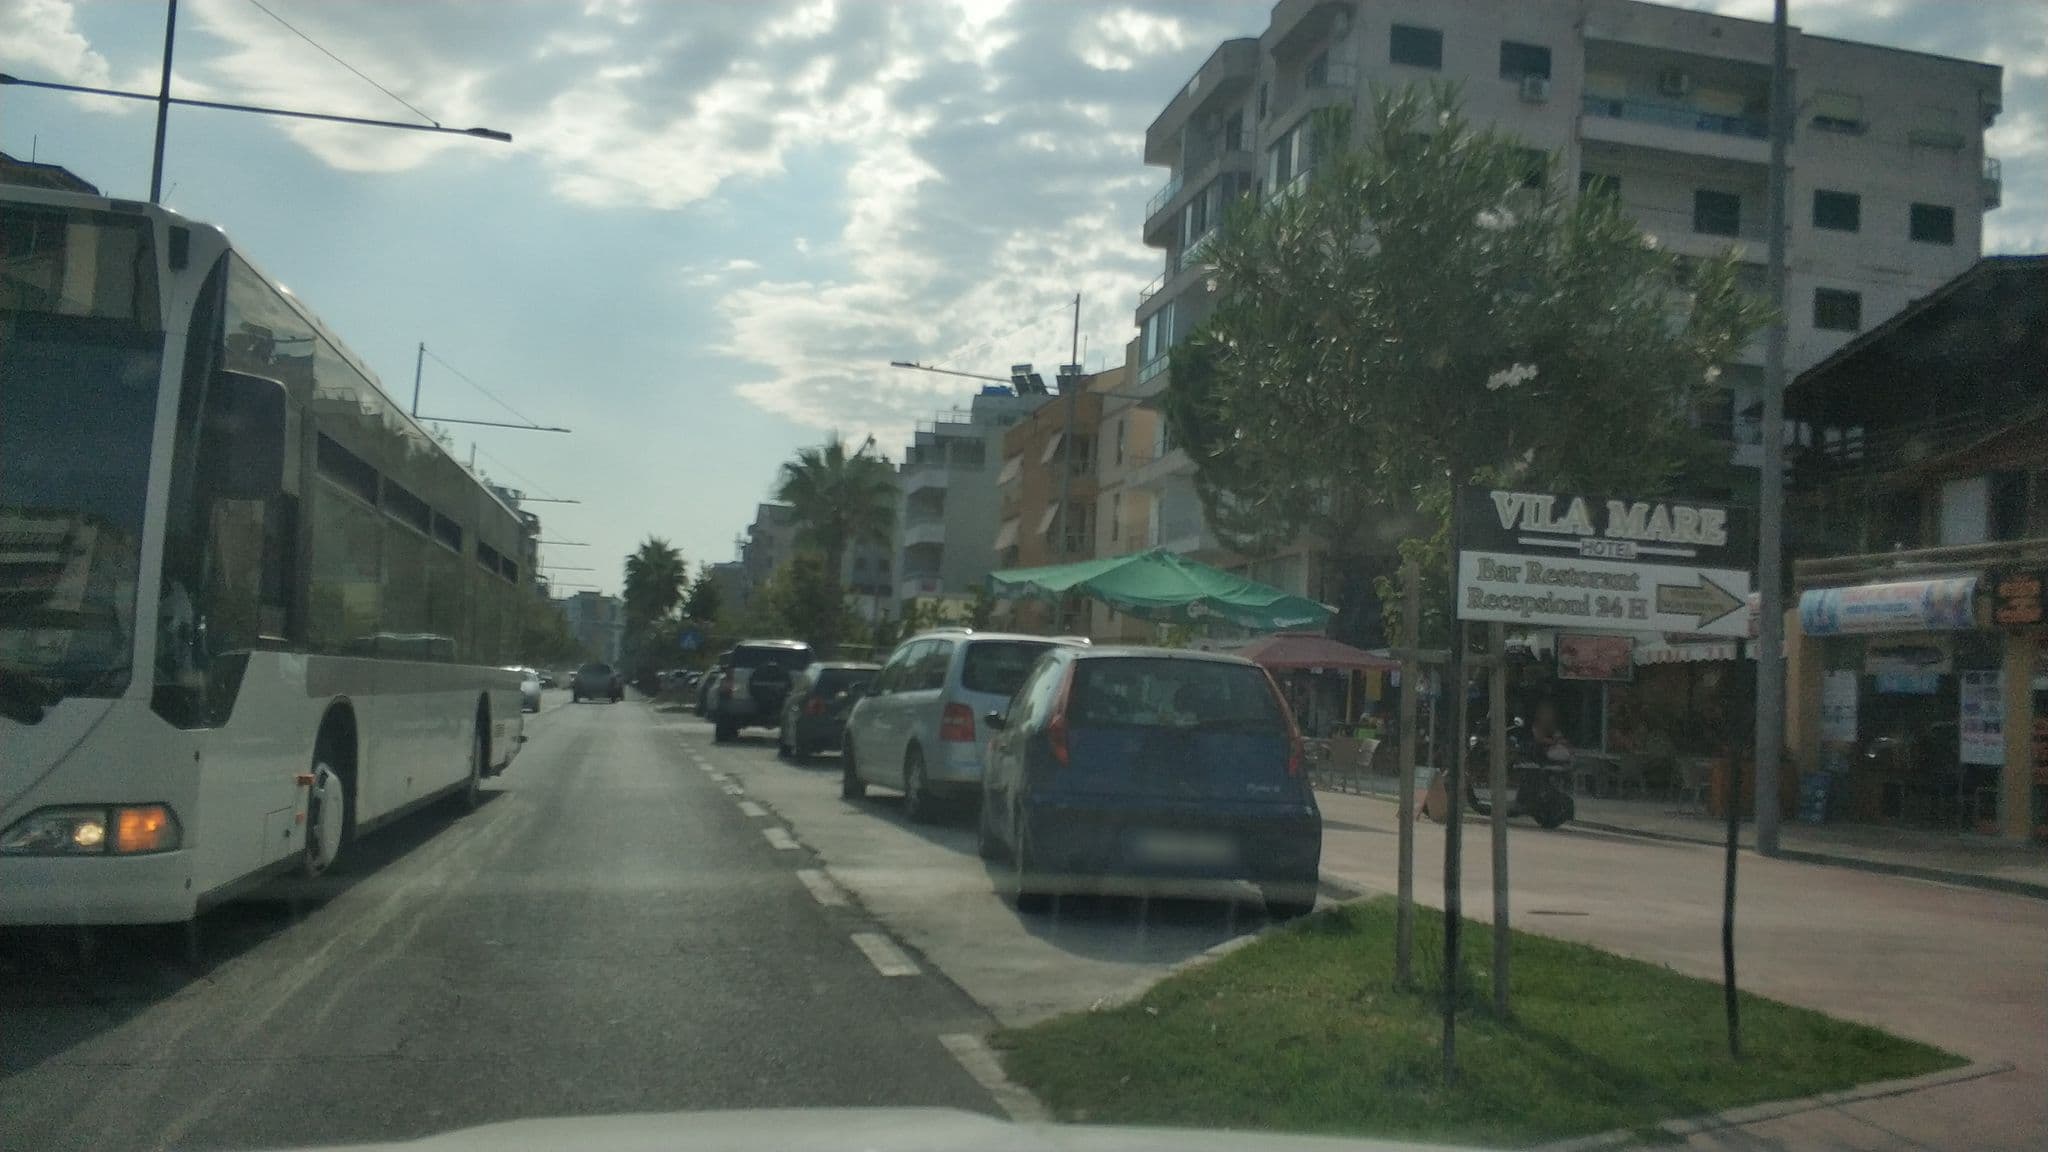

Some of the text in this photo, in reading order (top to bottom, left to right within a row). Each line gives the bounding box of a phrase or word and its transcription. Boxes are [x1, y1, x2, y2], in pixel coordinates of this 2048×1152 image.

[1490, 491, 1727, 546] VILA MARE
[1581, 541, 1636, 558] HOTEL
[1477, 558, 1520, 583] Bar
[1595, 596, 1624, 618] 24
[1628, 598, 1648, 619] H
